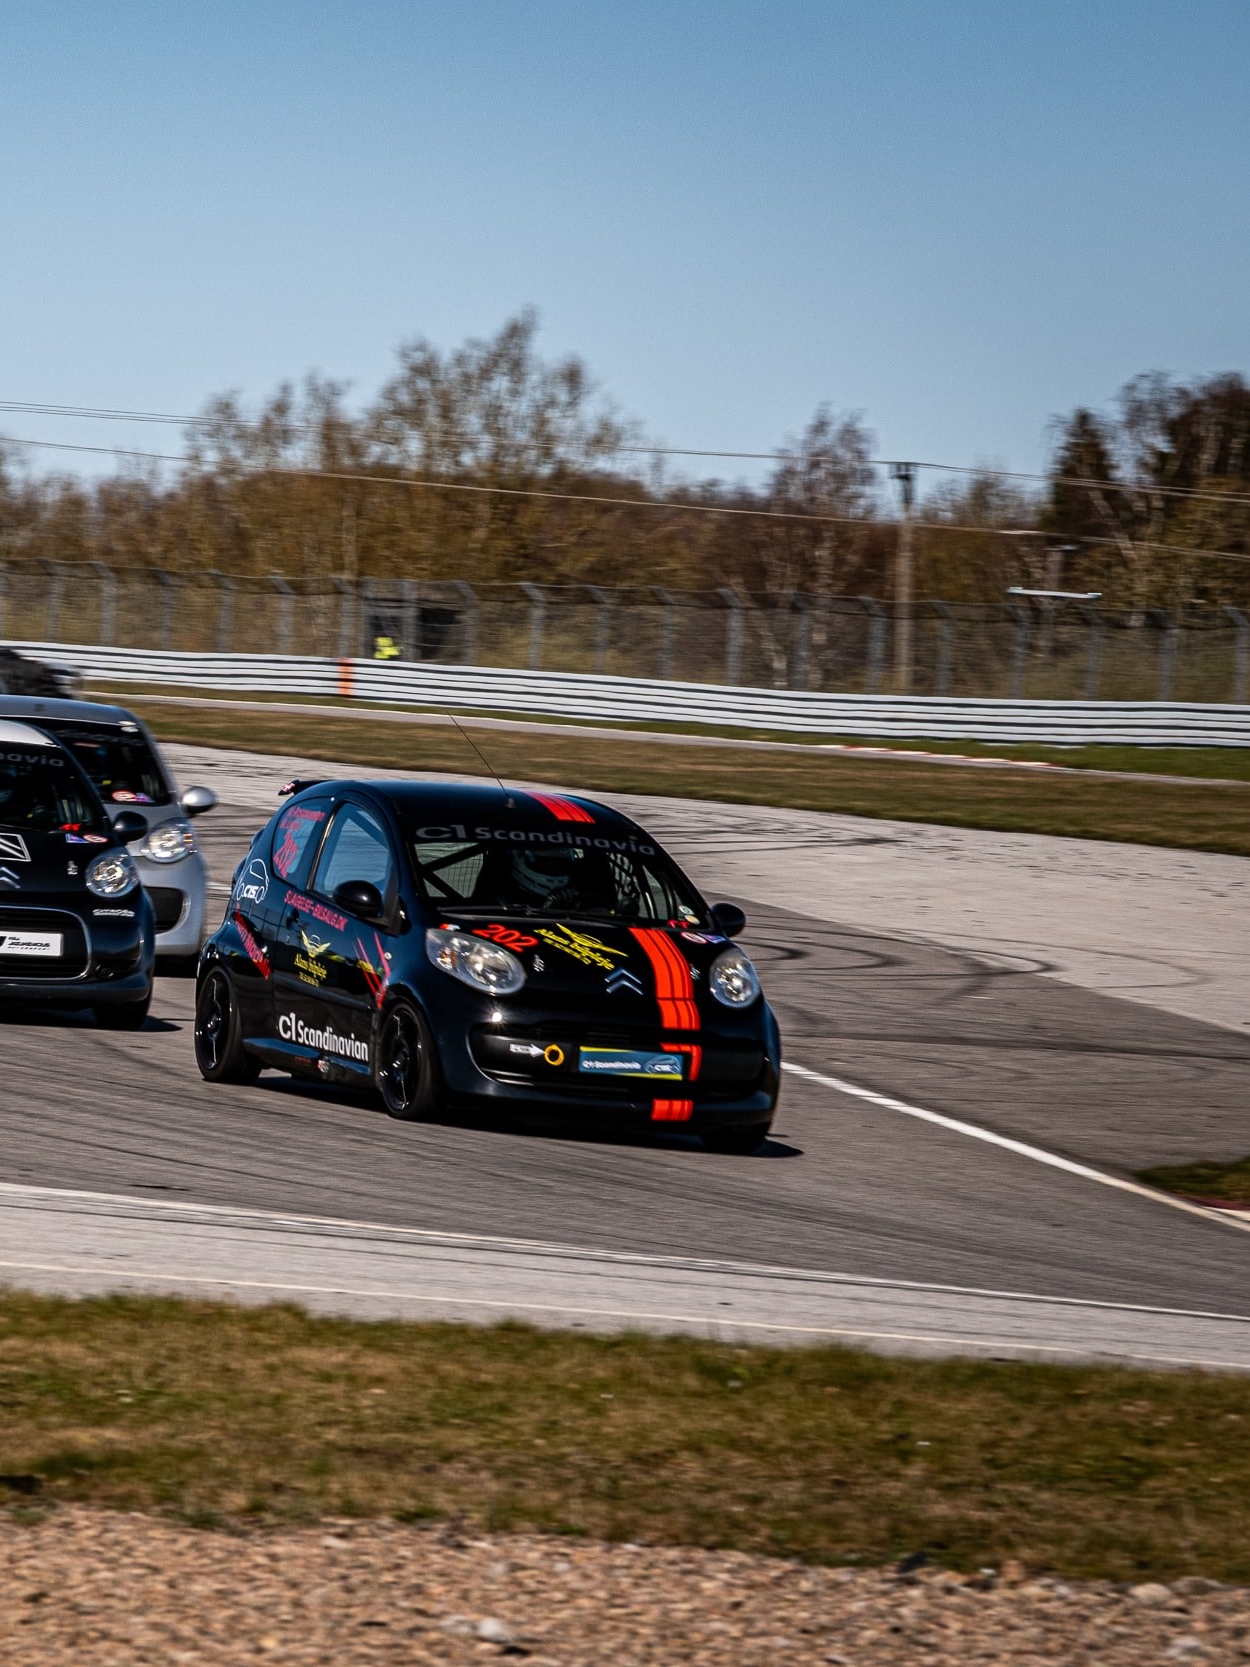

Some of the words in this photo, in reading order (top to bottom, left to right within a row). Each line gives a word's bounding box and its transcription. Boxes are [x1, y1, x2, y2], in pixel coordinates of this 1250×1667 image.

[415, 824, 467, 839] C1
[475, 826, 656, 855] Scandinavia
[472, 924, 539, 953] 202
[278, 1012, 297, 1042] C1
[297, 1019, 369, 1062] Scandinavian
